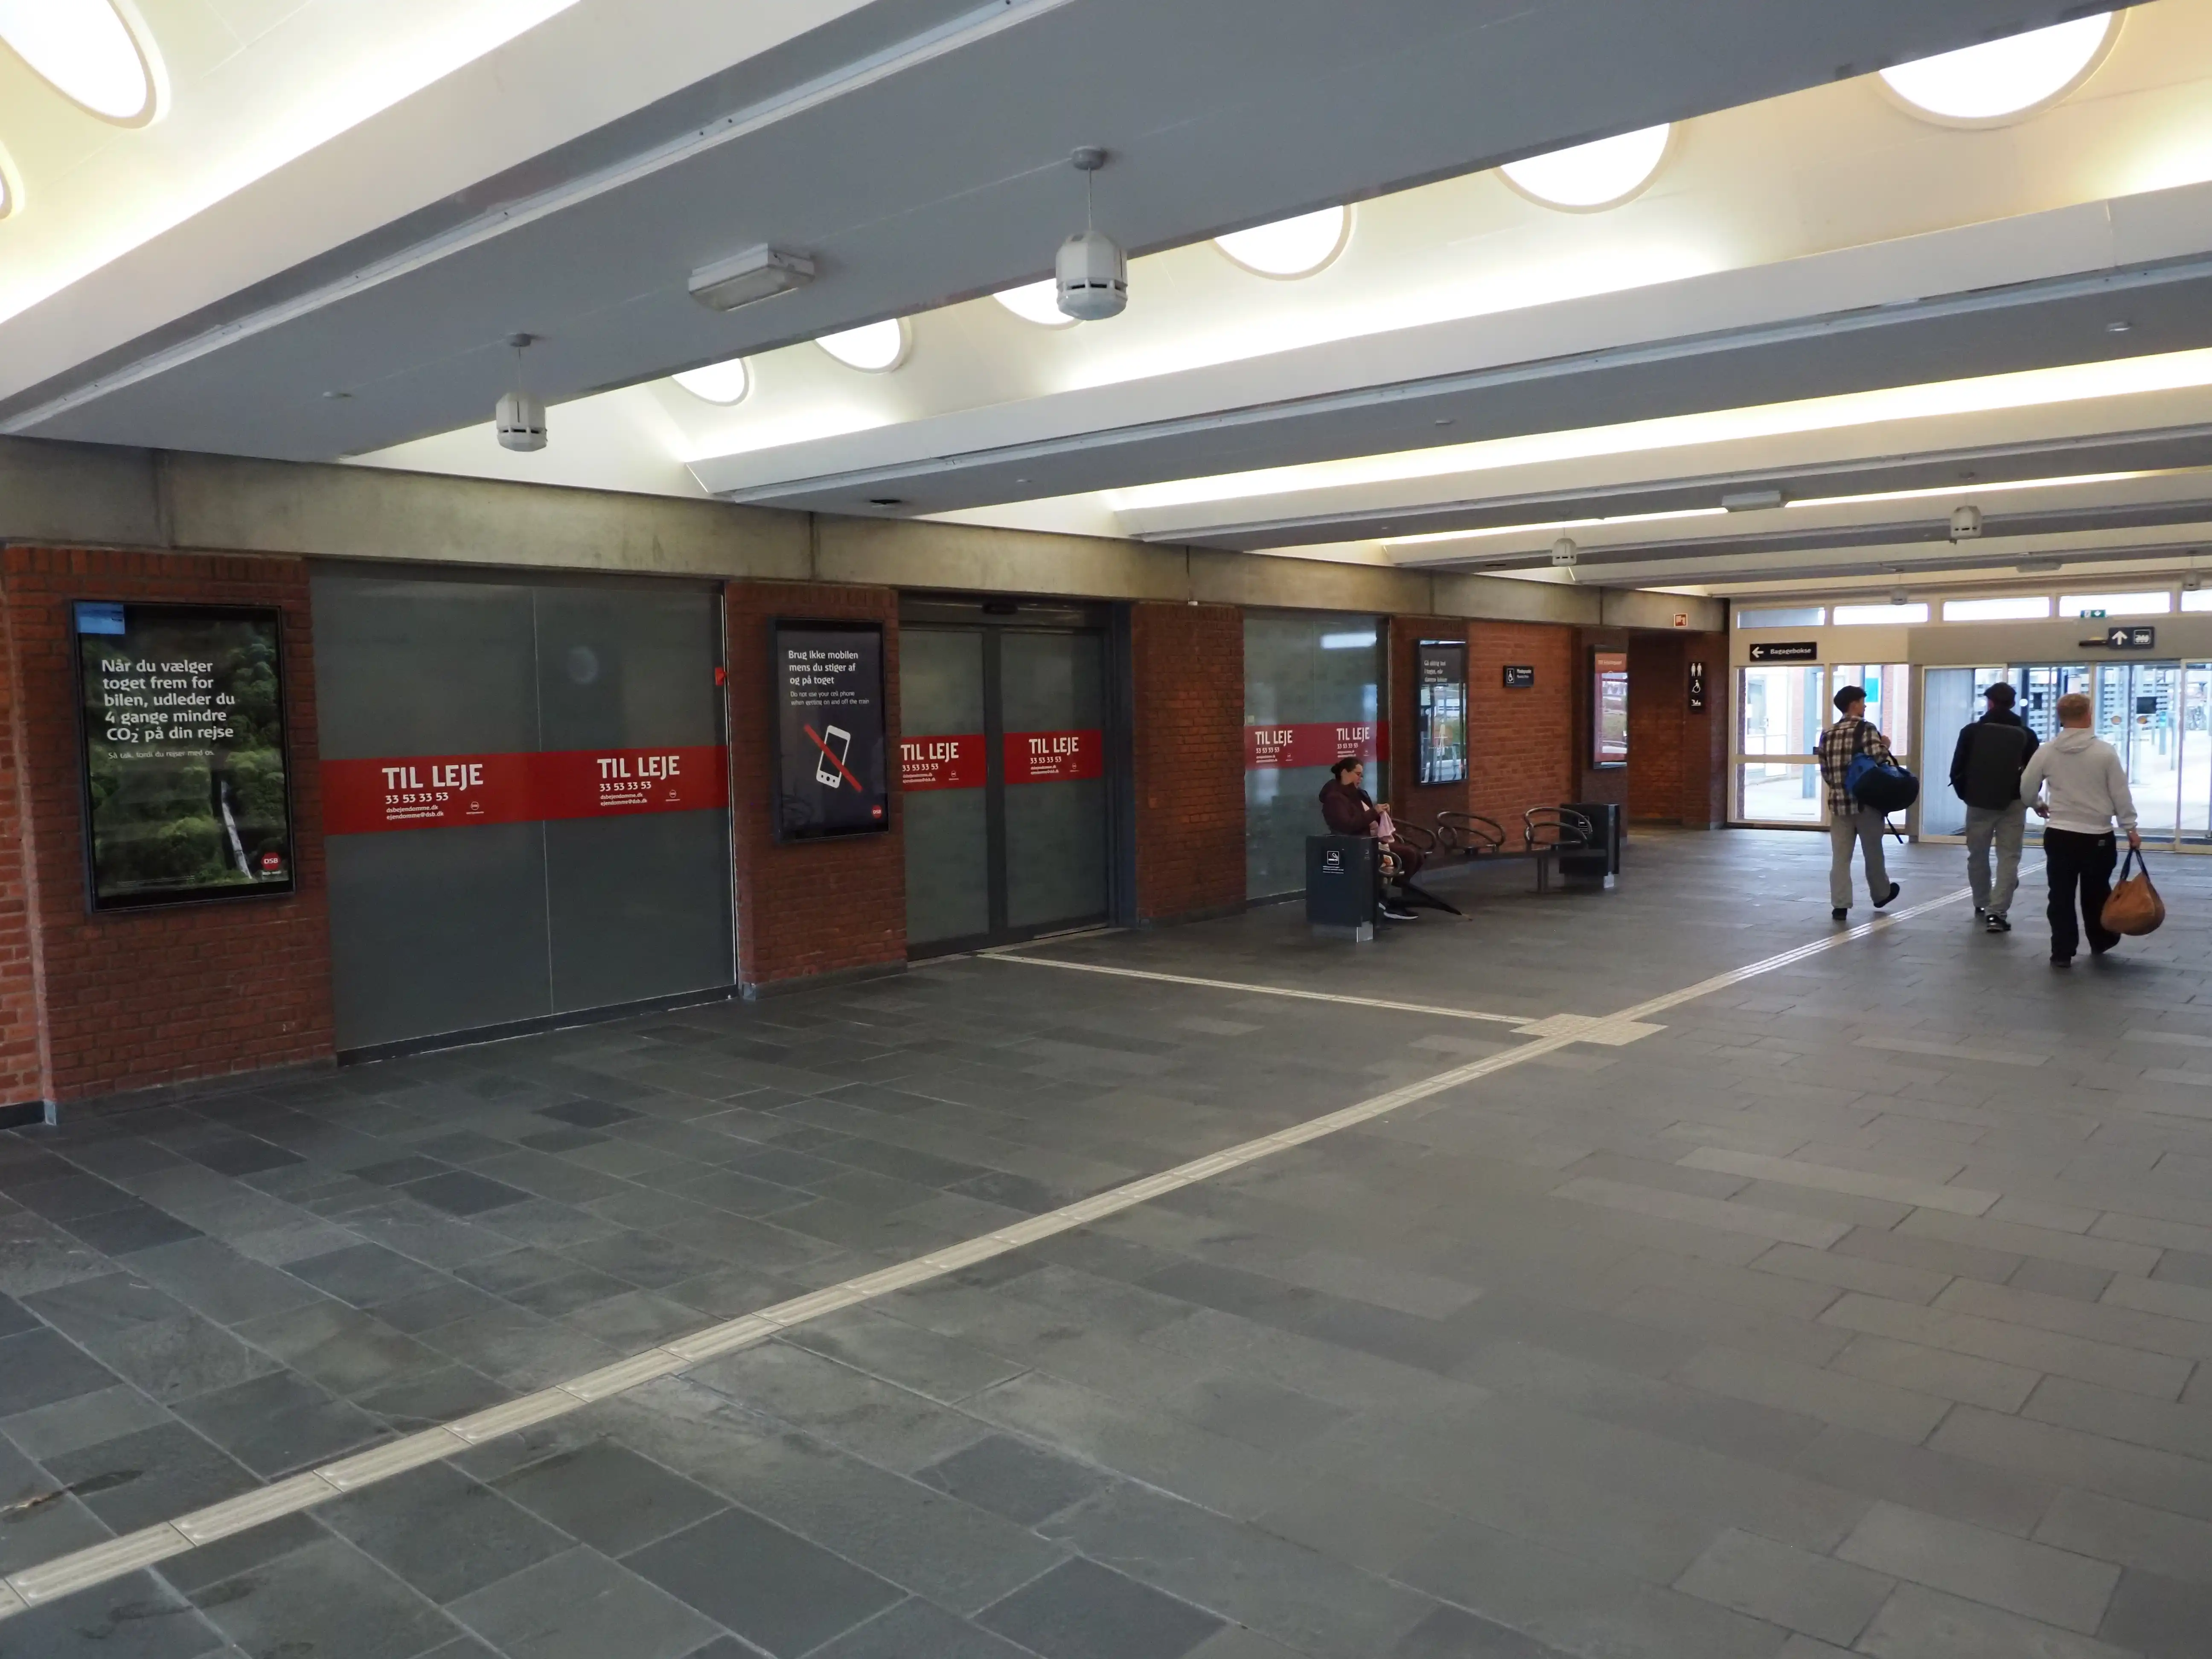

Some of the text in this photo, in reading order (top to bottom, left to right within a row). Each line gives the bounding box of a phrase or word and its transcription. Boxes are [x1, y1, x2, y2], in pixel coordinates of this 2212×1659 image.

[789, 650, 858, 660] Brug ikke mobilen
[102, 659, 213, 674] Når du vælger
[813, 663, 823, 671] du
[825, 664, 846, 672] stiger
[848, 663, 856, 671] af
[103, 676, 214, 691] toget frem for
[790, 675, 835, 686] og på toget
[104, 693, 235, 708] bilen, udleder du
[105, 709, 227, 725] 4 gange mindre
[145, 726, 164, 742] på
[169, 726, 192, 739] din
[198, 726, 234, 740] rejse
[1255, 730, 1292, 747] TIL LEJE
[1336, 727, 1370, 742] TIL LEJE
[900, 742, 959, 763] TIL LEJE
[1029, 737, 1079, 756] TIL LEJE
[597, 756, 680, 780] TIL LEJE
[382, 764, 483, 791] TIL LEJE
[600, 783, 611, 792] 33
[614, 783, 625, 791] 53
[627, 782, 638, 790] 33
[385, 792, 448, 804] 33 53 33 53
[386, 805, 438, 813] dsbejendomme.dk
[387, 811, 444, 820] ejendomme@dsb.dk
